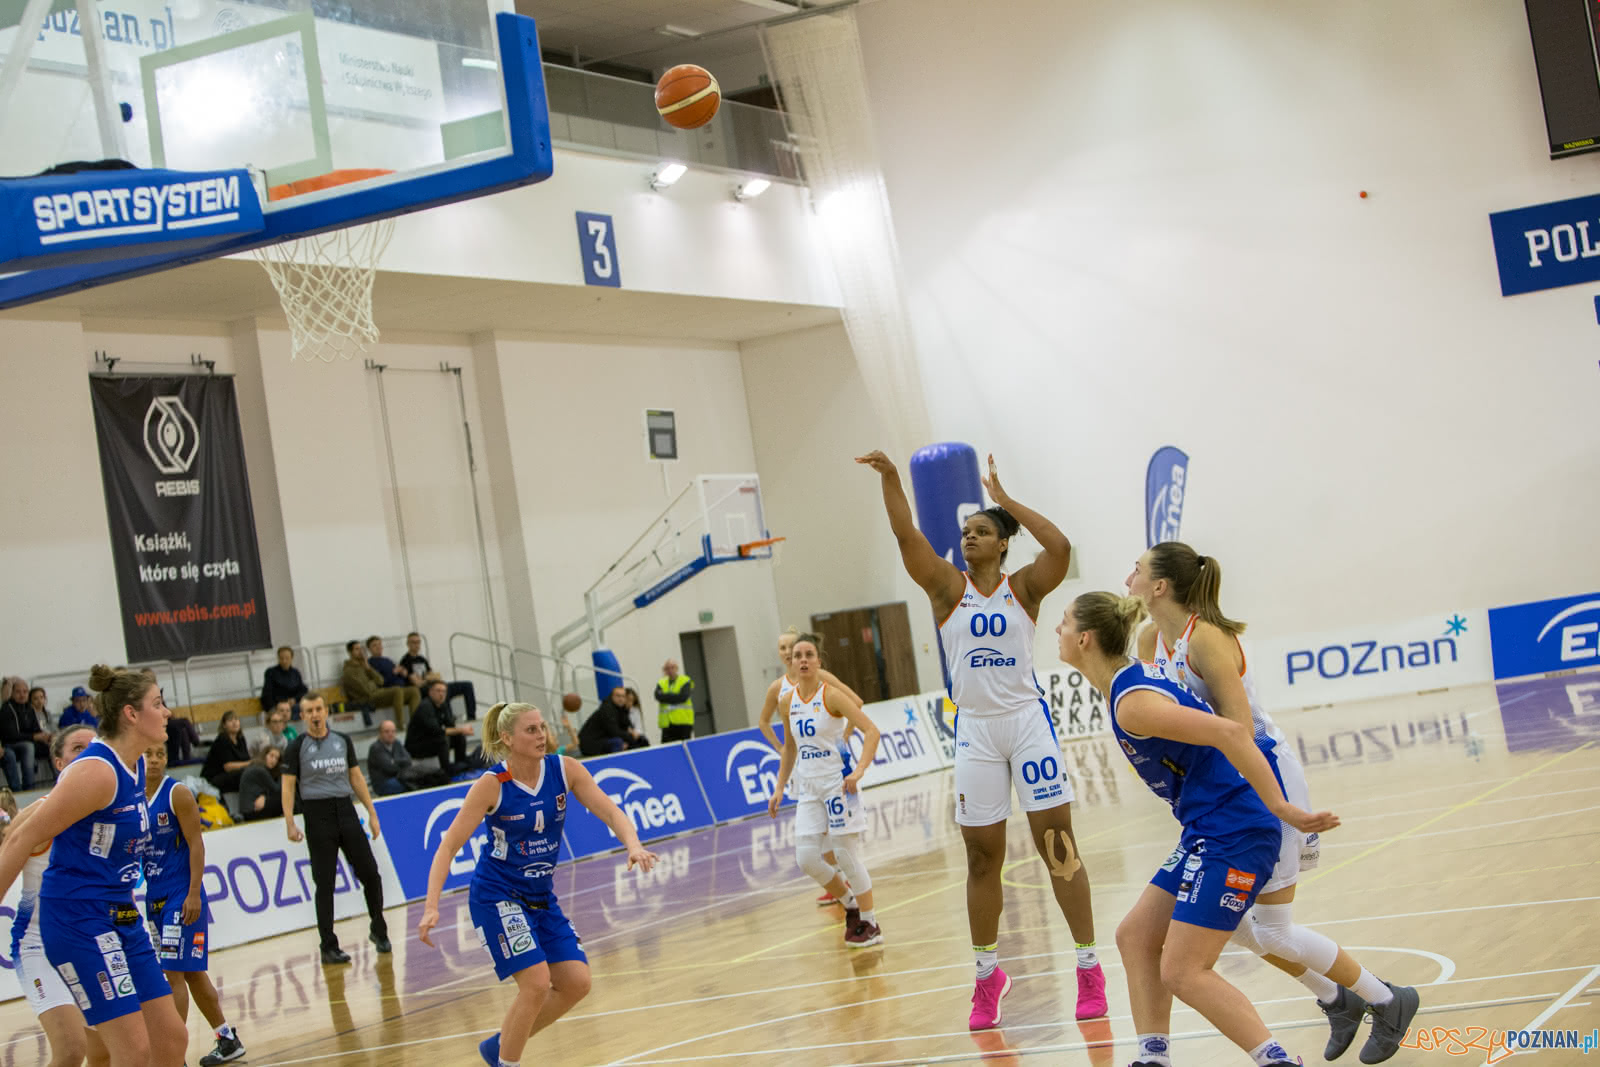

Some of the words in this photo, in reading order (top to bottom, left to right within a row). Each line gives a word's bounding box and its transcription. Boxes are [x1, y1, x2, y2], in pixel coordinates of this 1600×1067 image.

[588, 221, 612, 279] 3
[1523, 219, 1600, 268] POL
[155, 479, 200, 497] REBIS
[134, 531, 191, 555] Książki,
[139, 563, 177, 583] które
[181, 561, 199, 583] się
[203, 558, 240, 580] czyta
[135, 598, 256, 626] www.rebis.com.pl
[970, 613, 1007, 637] 00
[1560, 622, 1600, 662] E
[970, 655, 1016, 668] Enea
[796, 719, 816, 738] 16
[802, 749, 831, 760] Enea
[1022, 756, 1058, 784] 00
[825, 797, 844, 815] 16
[533, 810, 545, 834] 4
[1222, 893, 1246, 912] Foxy
[507, 924, 527, 934] BERG
